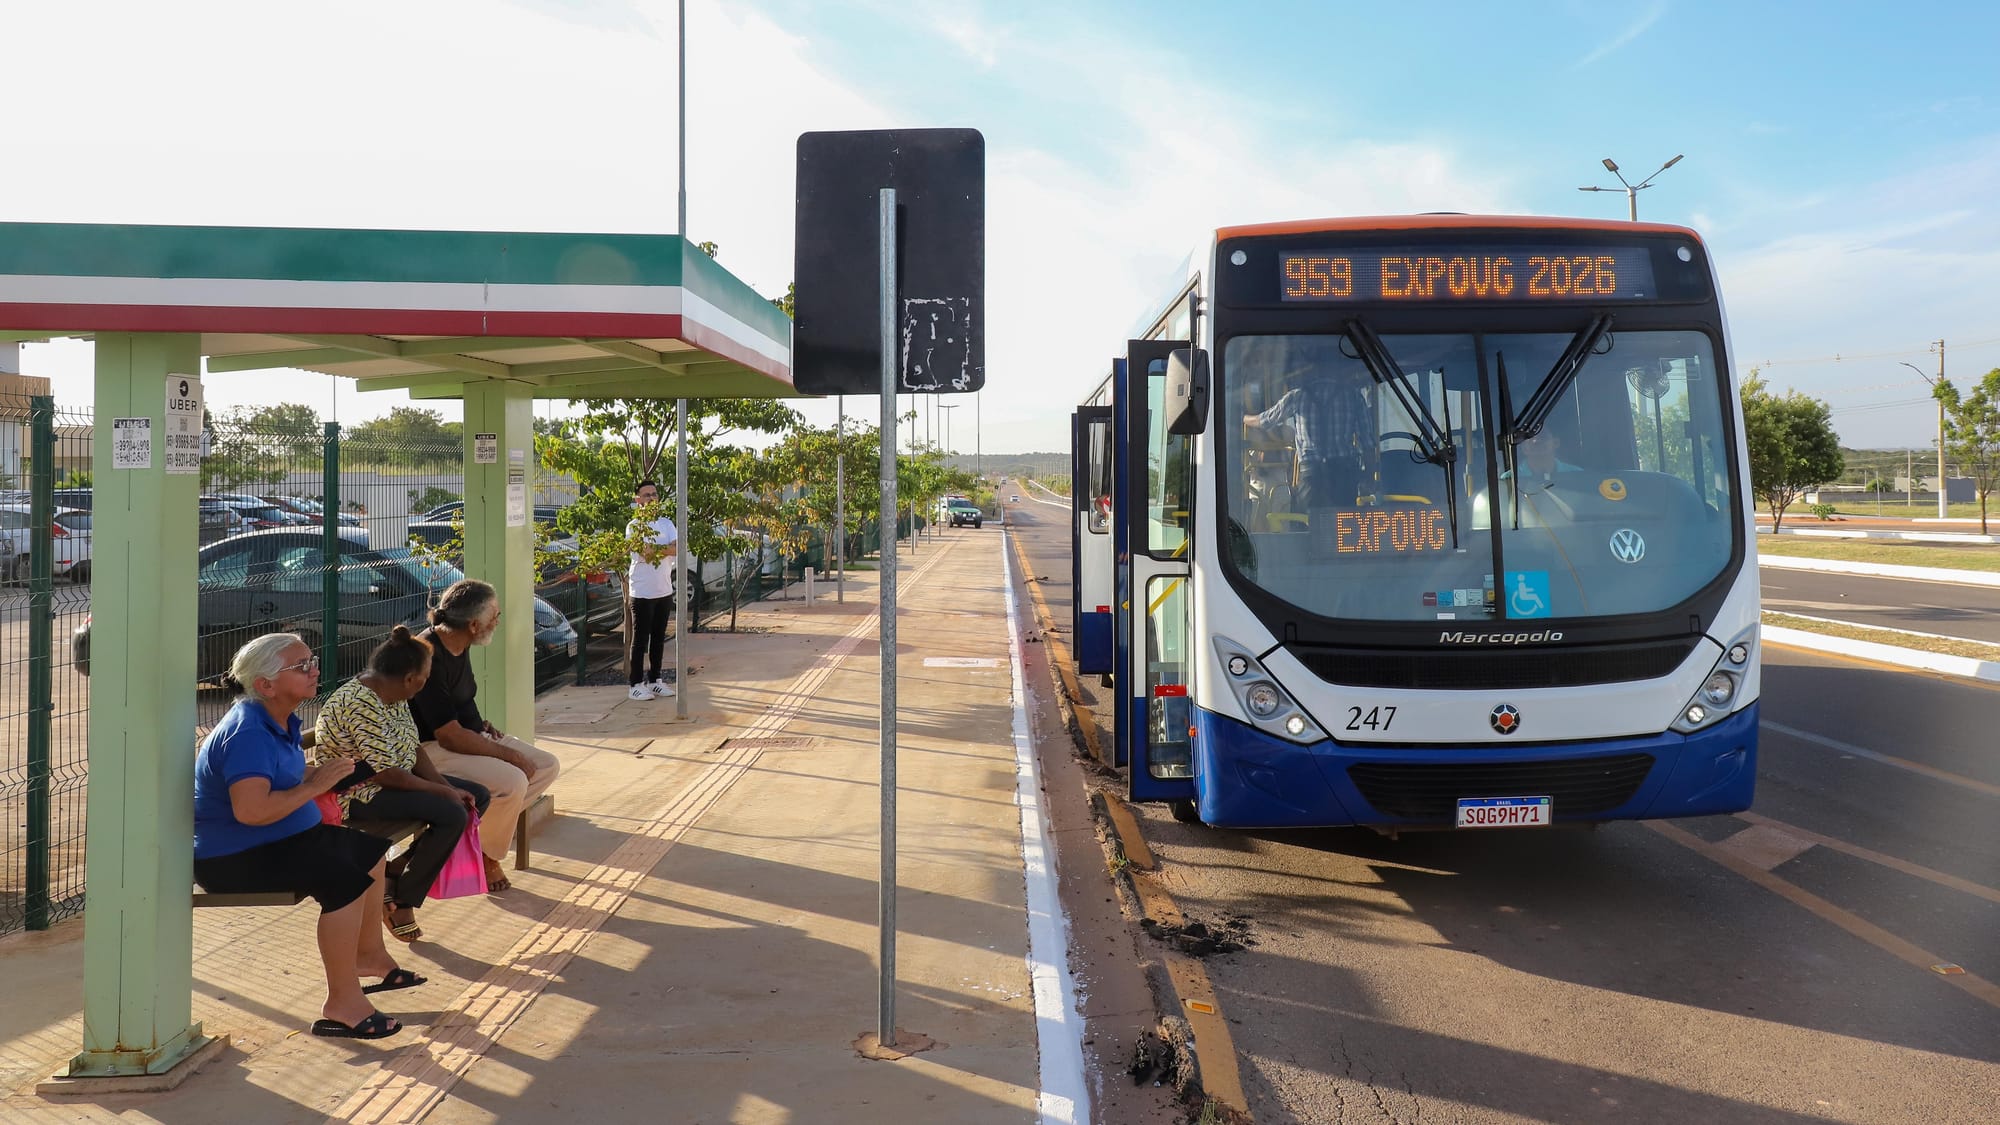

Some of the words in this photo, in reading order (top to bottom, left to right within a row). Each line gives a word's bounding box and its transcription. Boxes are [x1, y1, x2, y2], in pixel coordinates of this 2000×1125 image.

[1286, 257, 1352, 296] 959
[1381, 257, 1513, 296] EXPOVG
[1528, 256, 1616, 295] 2026
[169, 399, 197, 411] UBER
[1337, 510, 1445, 552] EXPOVG
[1440, 630, 1563, 645] Marcopolo
[1346, 706, 1397, 730] 247
[1465, 806, 1539, 824] SQG9H71
